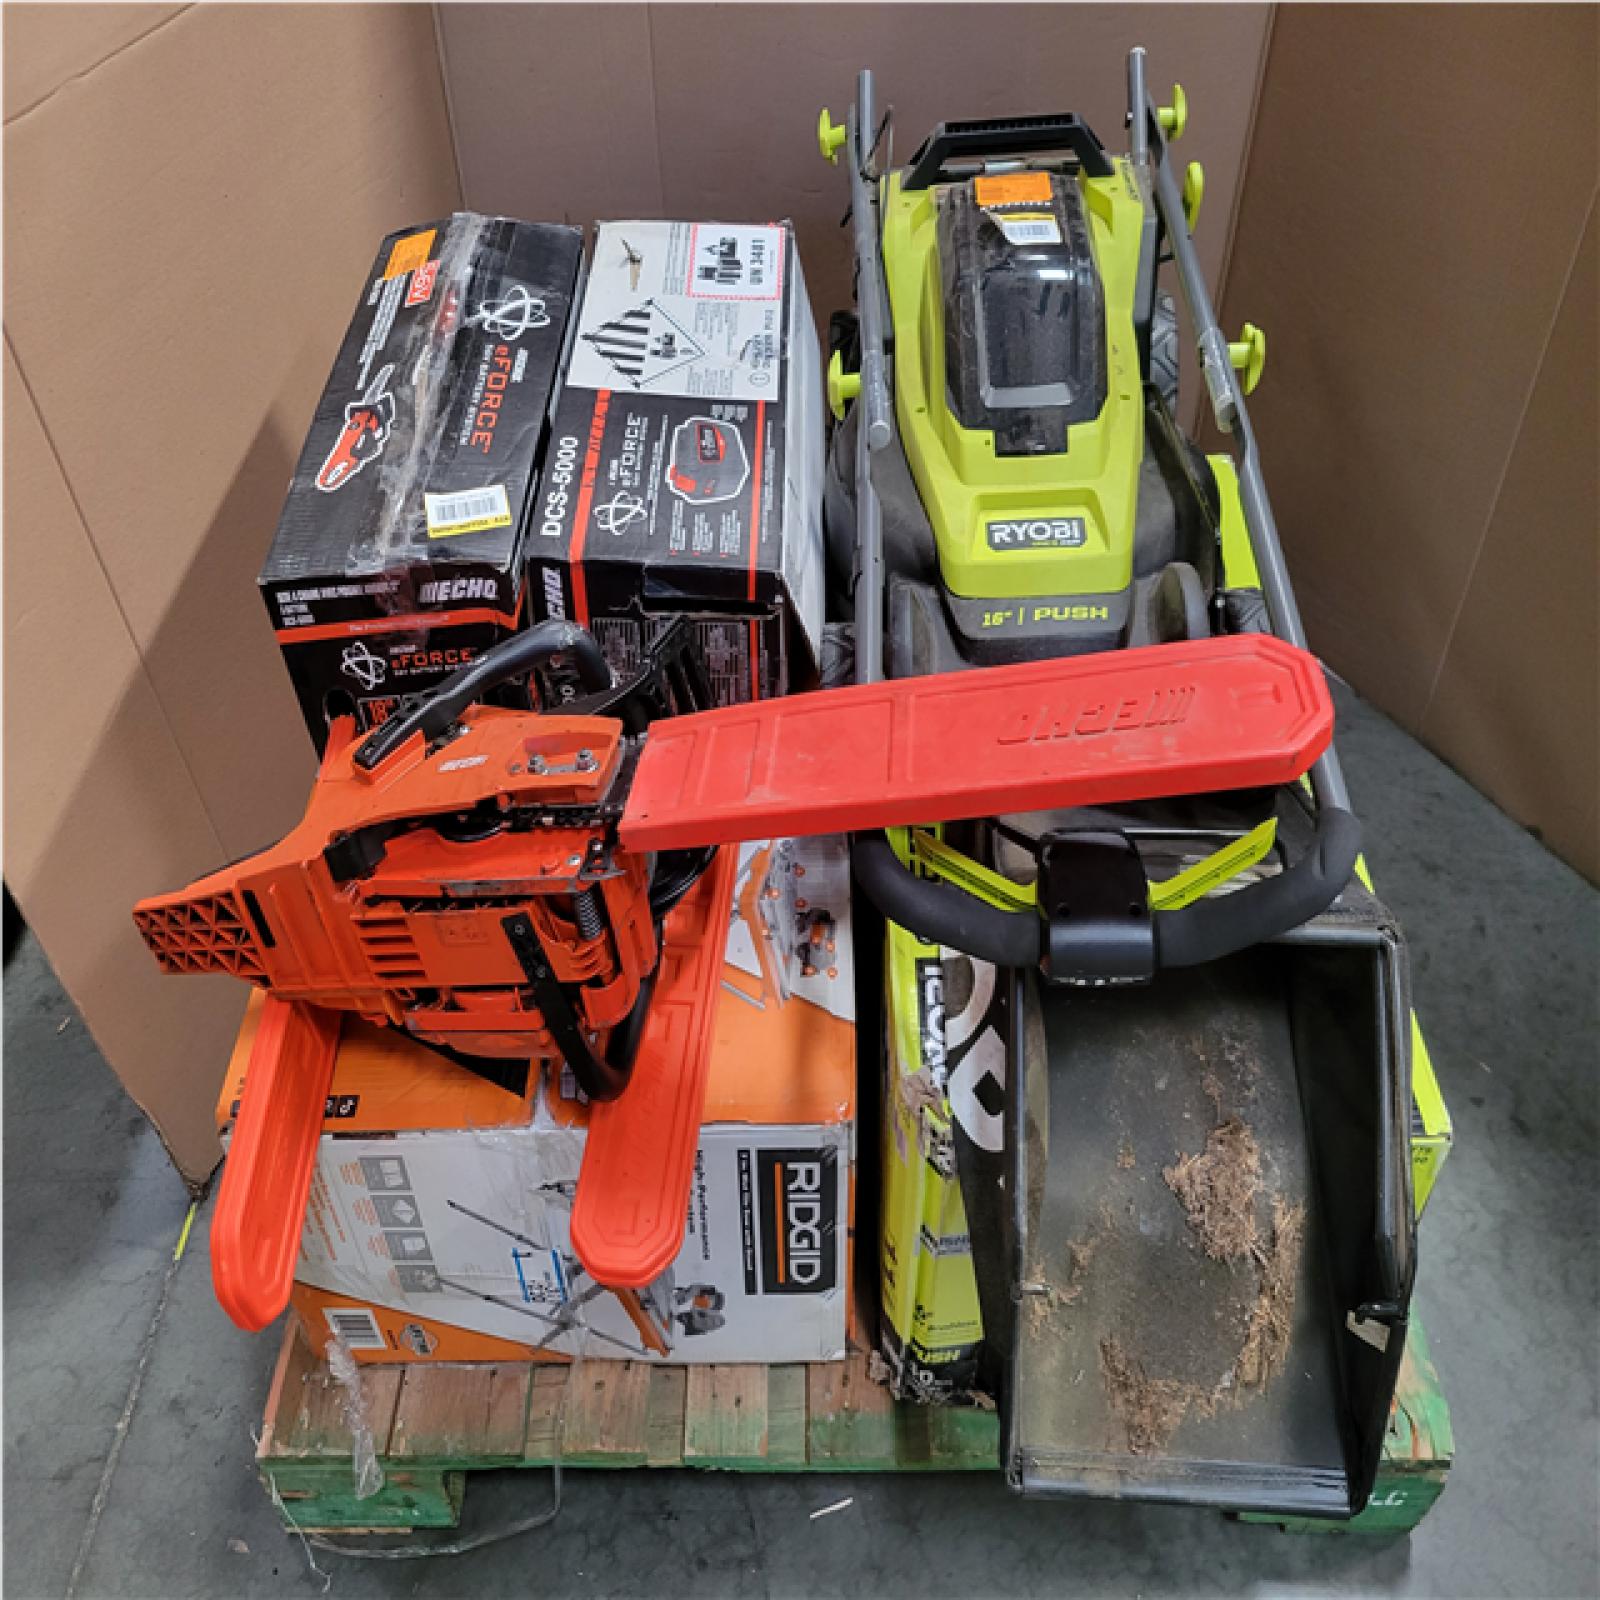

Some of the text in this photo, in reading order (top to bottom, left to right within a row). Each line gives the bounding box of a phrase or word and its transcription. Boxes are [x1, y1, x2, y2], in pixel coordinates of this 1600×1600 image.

[470, 344, 511, 449] eFORCE
[540, 436, 579, 536] DCS-5000
[990, 520, 1081, 543] RYOBI
[1034, 606, 1109, 621] PUSH
[391, 647, 472, 669] eFORCE
[786, 1161, 821, 1285] RIDGID
